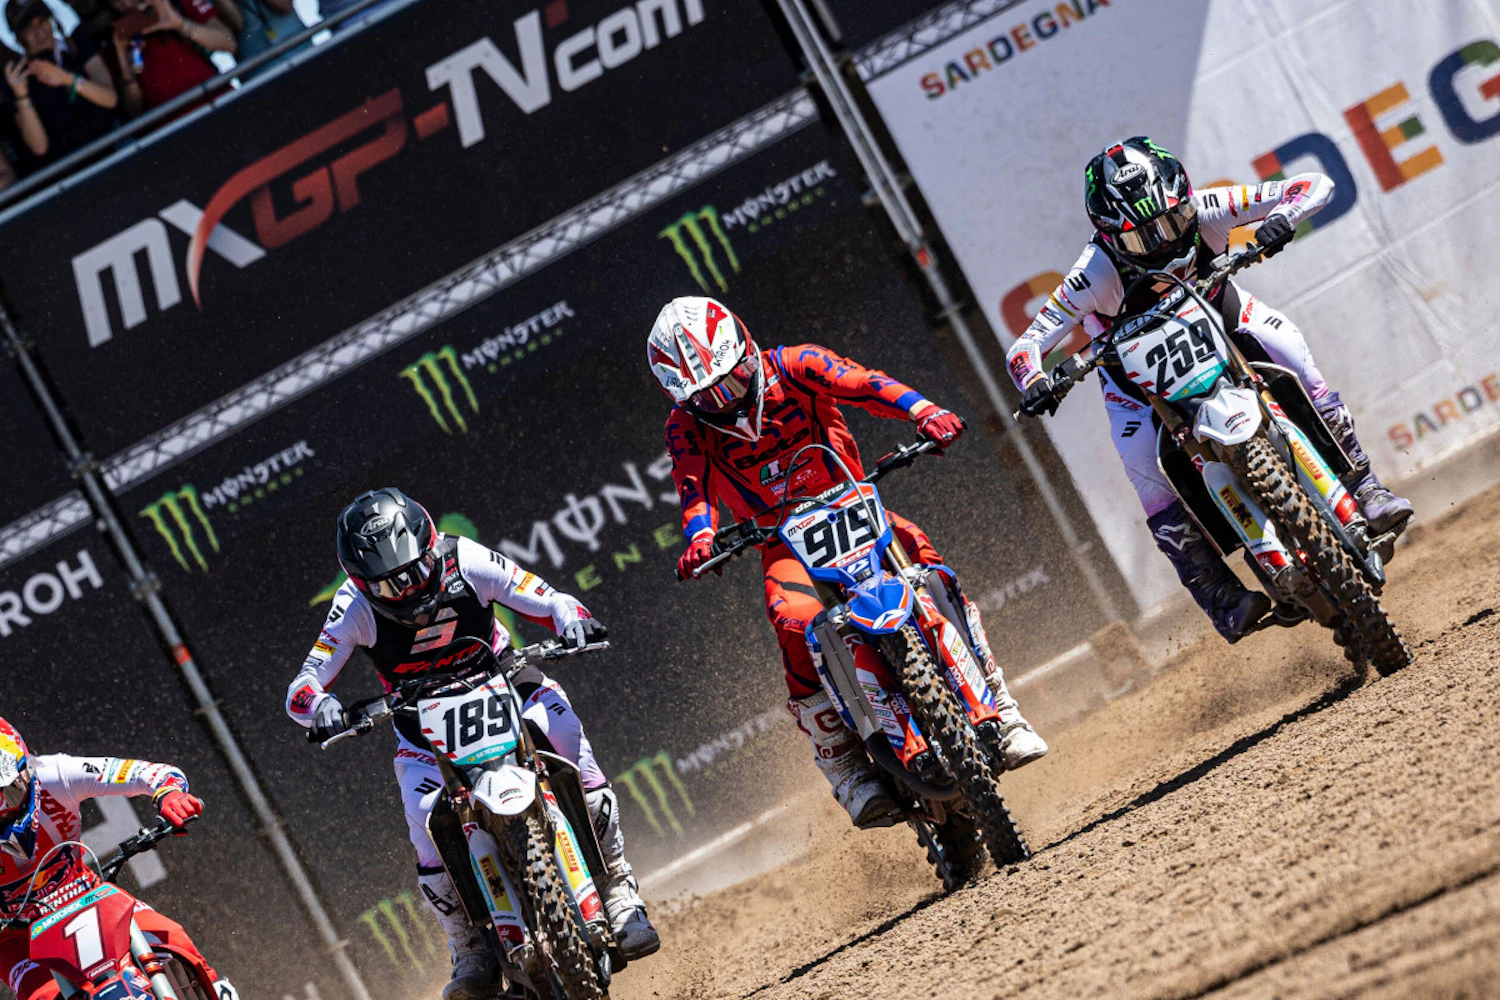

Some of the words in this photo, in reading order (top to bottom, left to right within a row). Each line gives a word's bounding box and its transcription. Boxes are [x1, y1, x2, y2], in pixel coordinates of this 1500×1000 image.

[721, 159, 838, 230] MONSTER
[461, 300, 577, 371] MONSTER
[713, 339, 733, 367] AIROH
[1145, 318, 1217, 394] 259
[201, 440, 315, 511] MONSTER
[734, 427, 811, 470] Beta
[1292, 440, 1324, 481] PIRELLI
[794, 483, 844, 514] domino
[803, 498, 878, 568] 919
[445, 694, 513, 752] 189
[559, 831, 579, 873] PIRELLI
[42, 900, 82, 928] MOTOREX
[64, 906, 105, 971] 1
